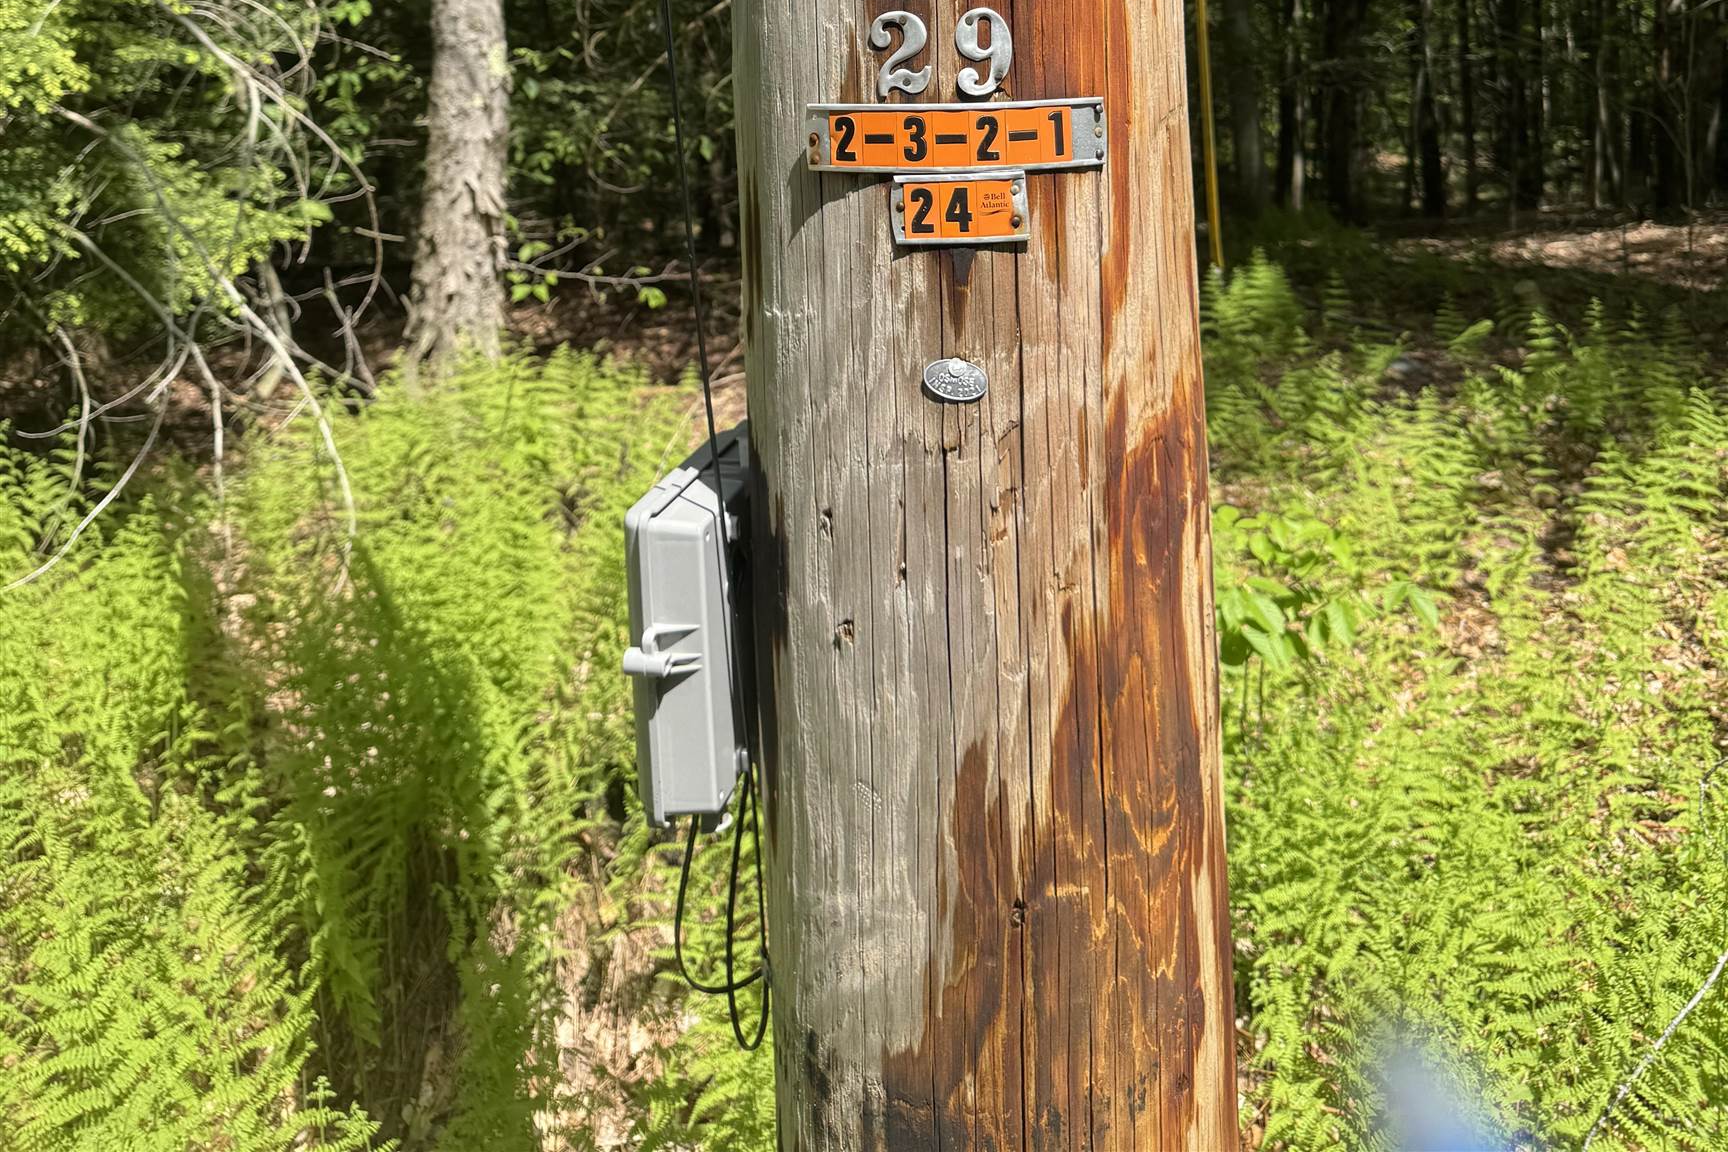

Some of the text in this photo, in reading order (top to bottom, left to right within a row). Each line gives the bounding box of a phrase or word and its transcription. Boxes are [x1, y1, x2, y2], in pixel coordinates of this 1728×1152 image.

[870, 7, 1012, 97] 29
[834, 110, 1065, 162] 2-3-2-1
[910, 187, 973, 234] 24
[981, 201, 1009, 209] Atlantic
[991, 192, 1006, 200] Bell
